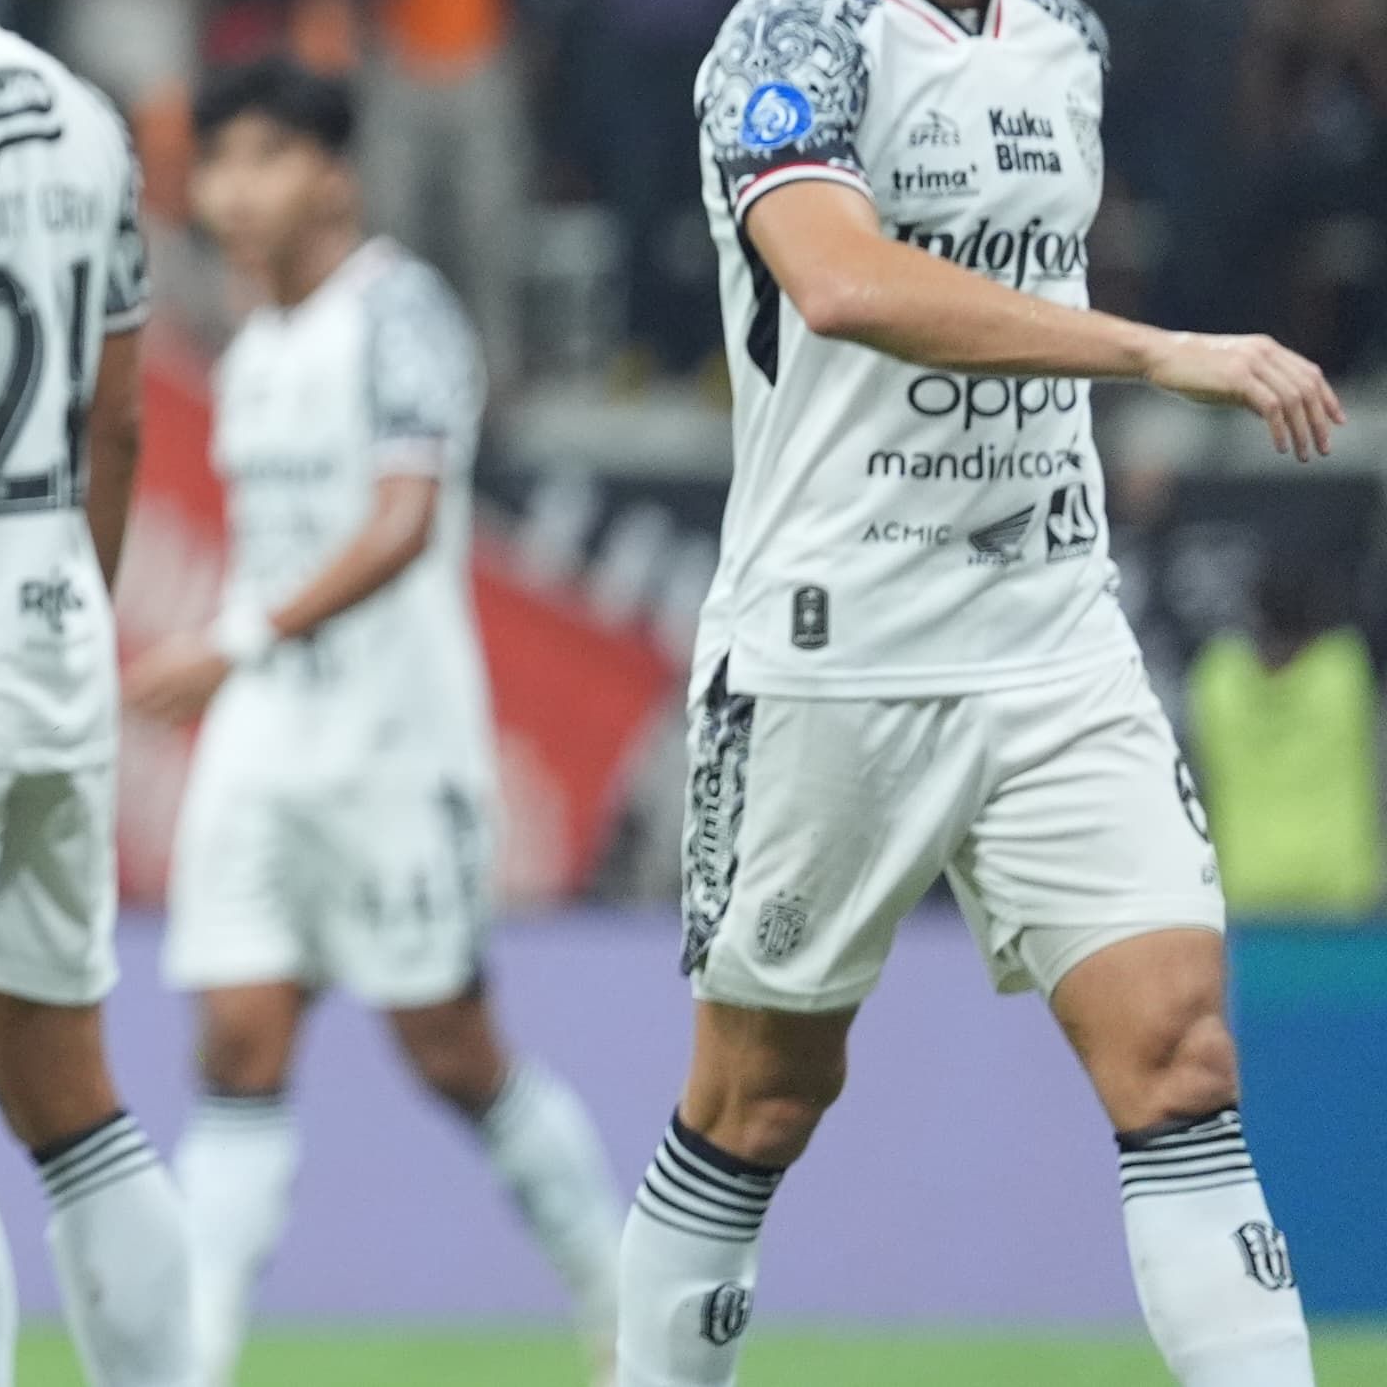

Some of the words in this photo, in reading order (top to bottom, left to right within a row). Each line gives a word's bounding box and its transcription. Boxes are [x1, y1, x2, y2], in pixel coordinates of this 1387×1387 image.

[988, 108, 1055, 139] Kuku
[996, 142, 1062, 173] Bima
[892, 164, 968, 191] trima
[862, 519, 953, 546] ACMIC
